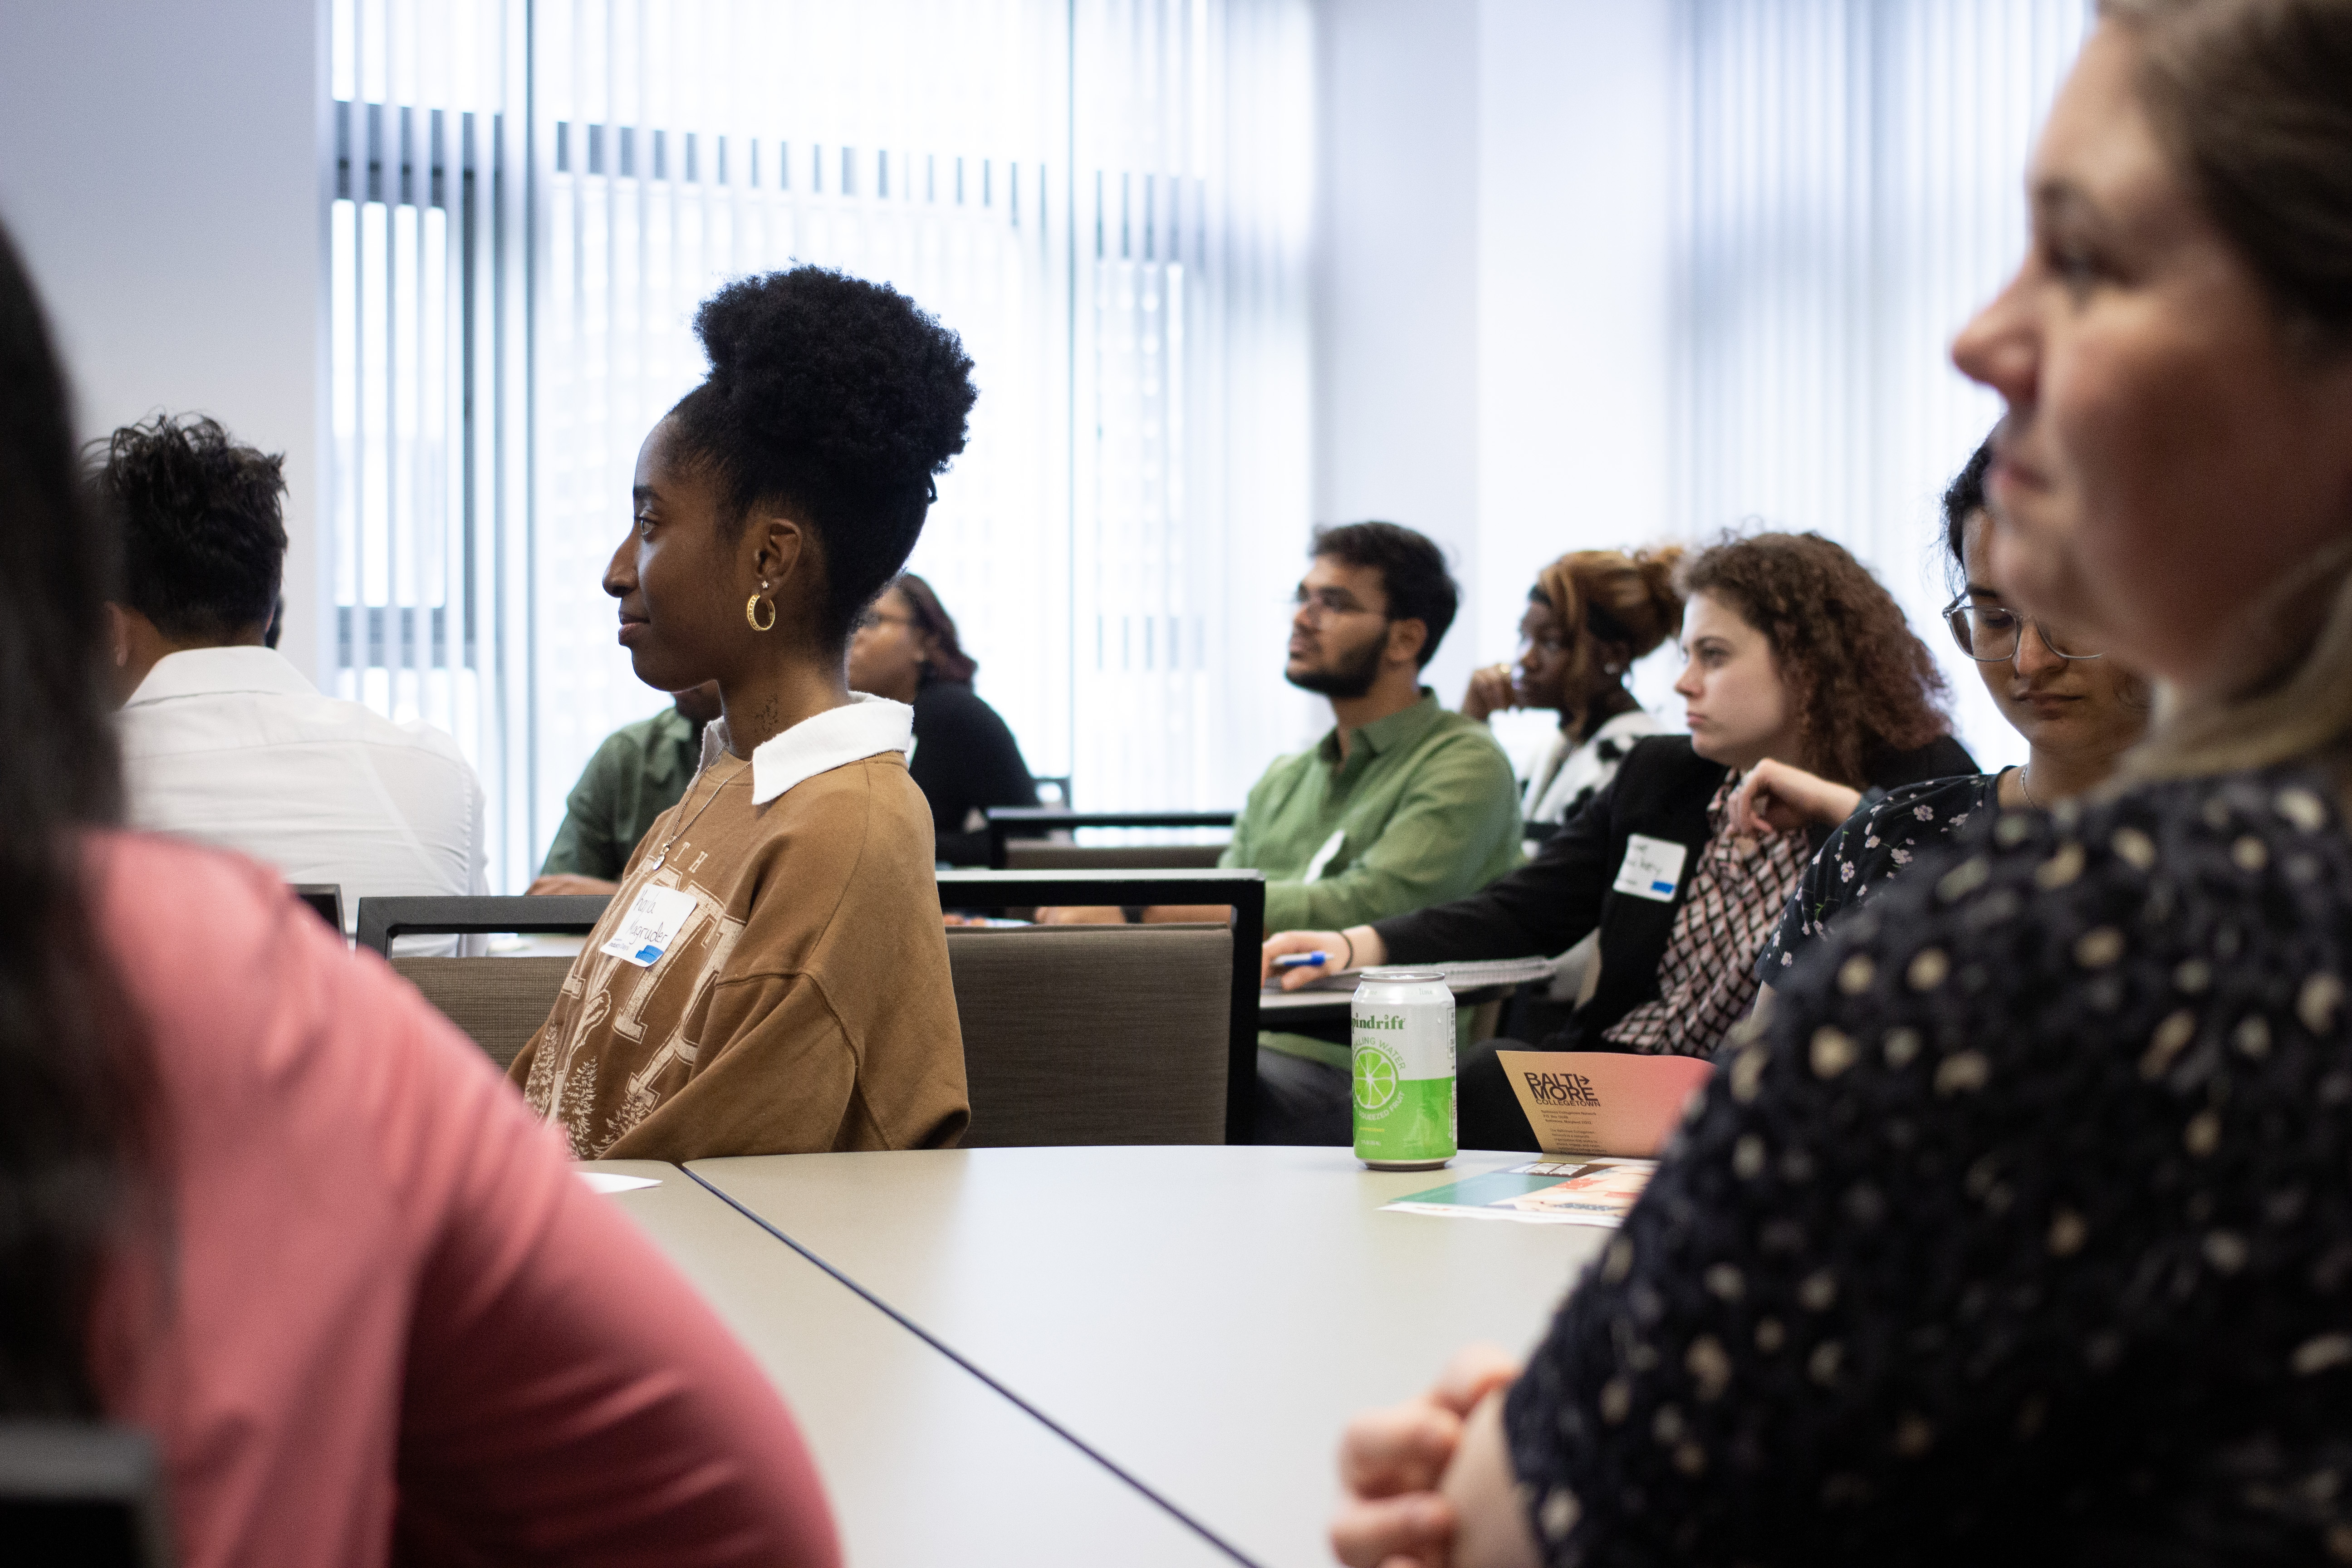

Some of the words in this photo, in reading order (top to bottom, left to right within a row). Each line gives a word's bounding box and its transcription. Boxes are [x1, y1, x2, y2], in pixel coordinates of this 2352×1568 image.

[1352, 1013, 1406, 1034] pindrift
[1379, 1039, 1406, 1070] WATER
[1532, 1085, 1598, 1101] MORE
